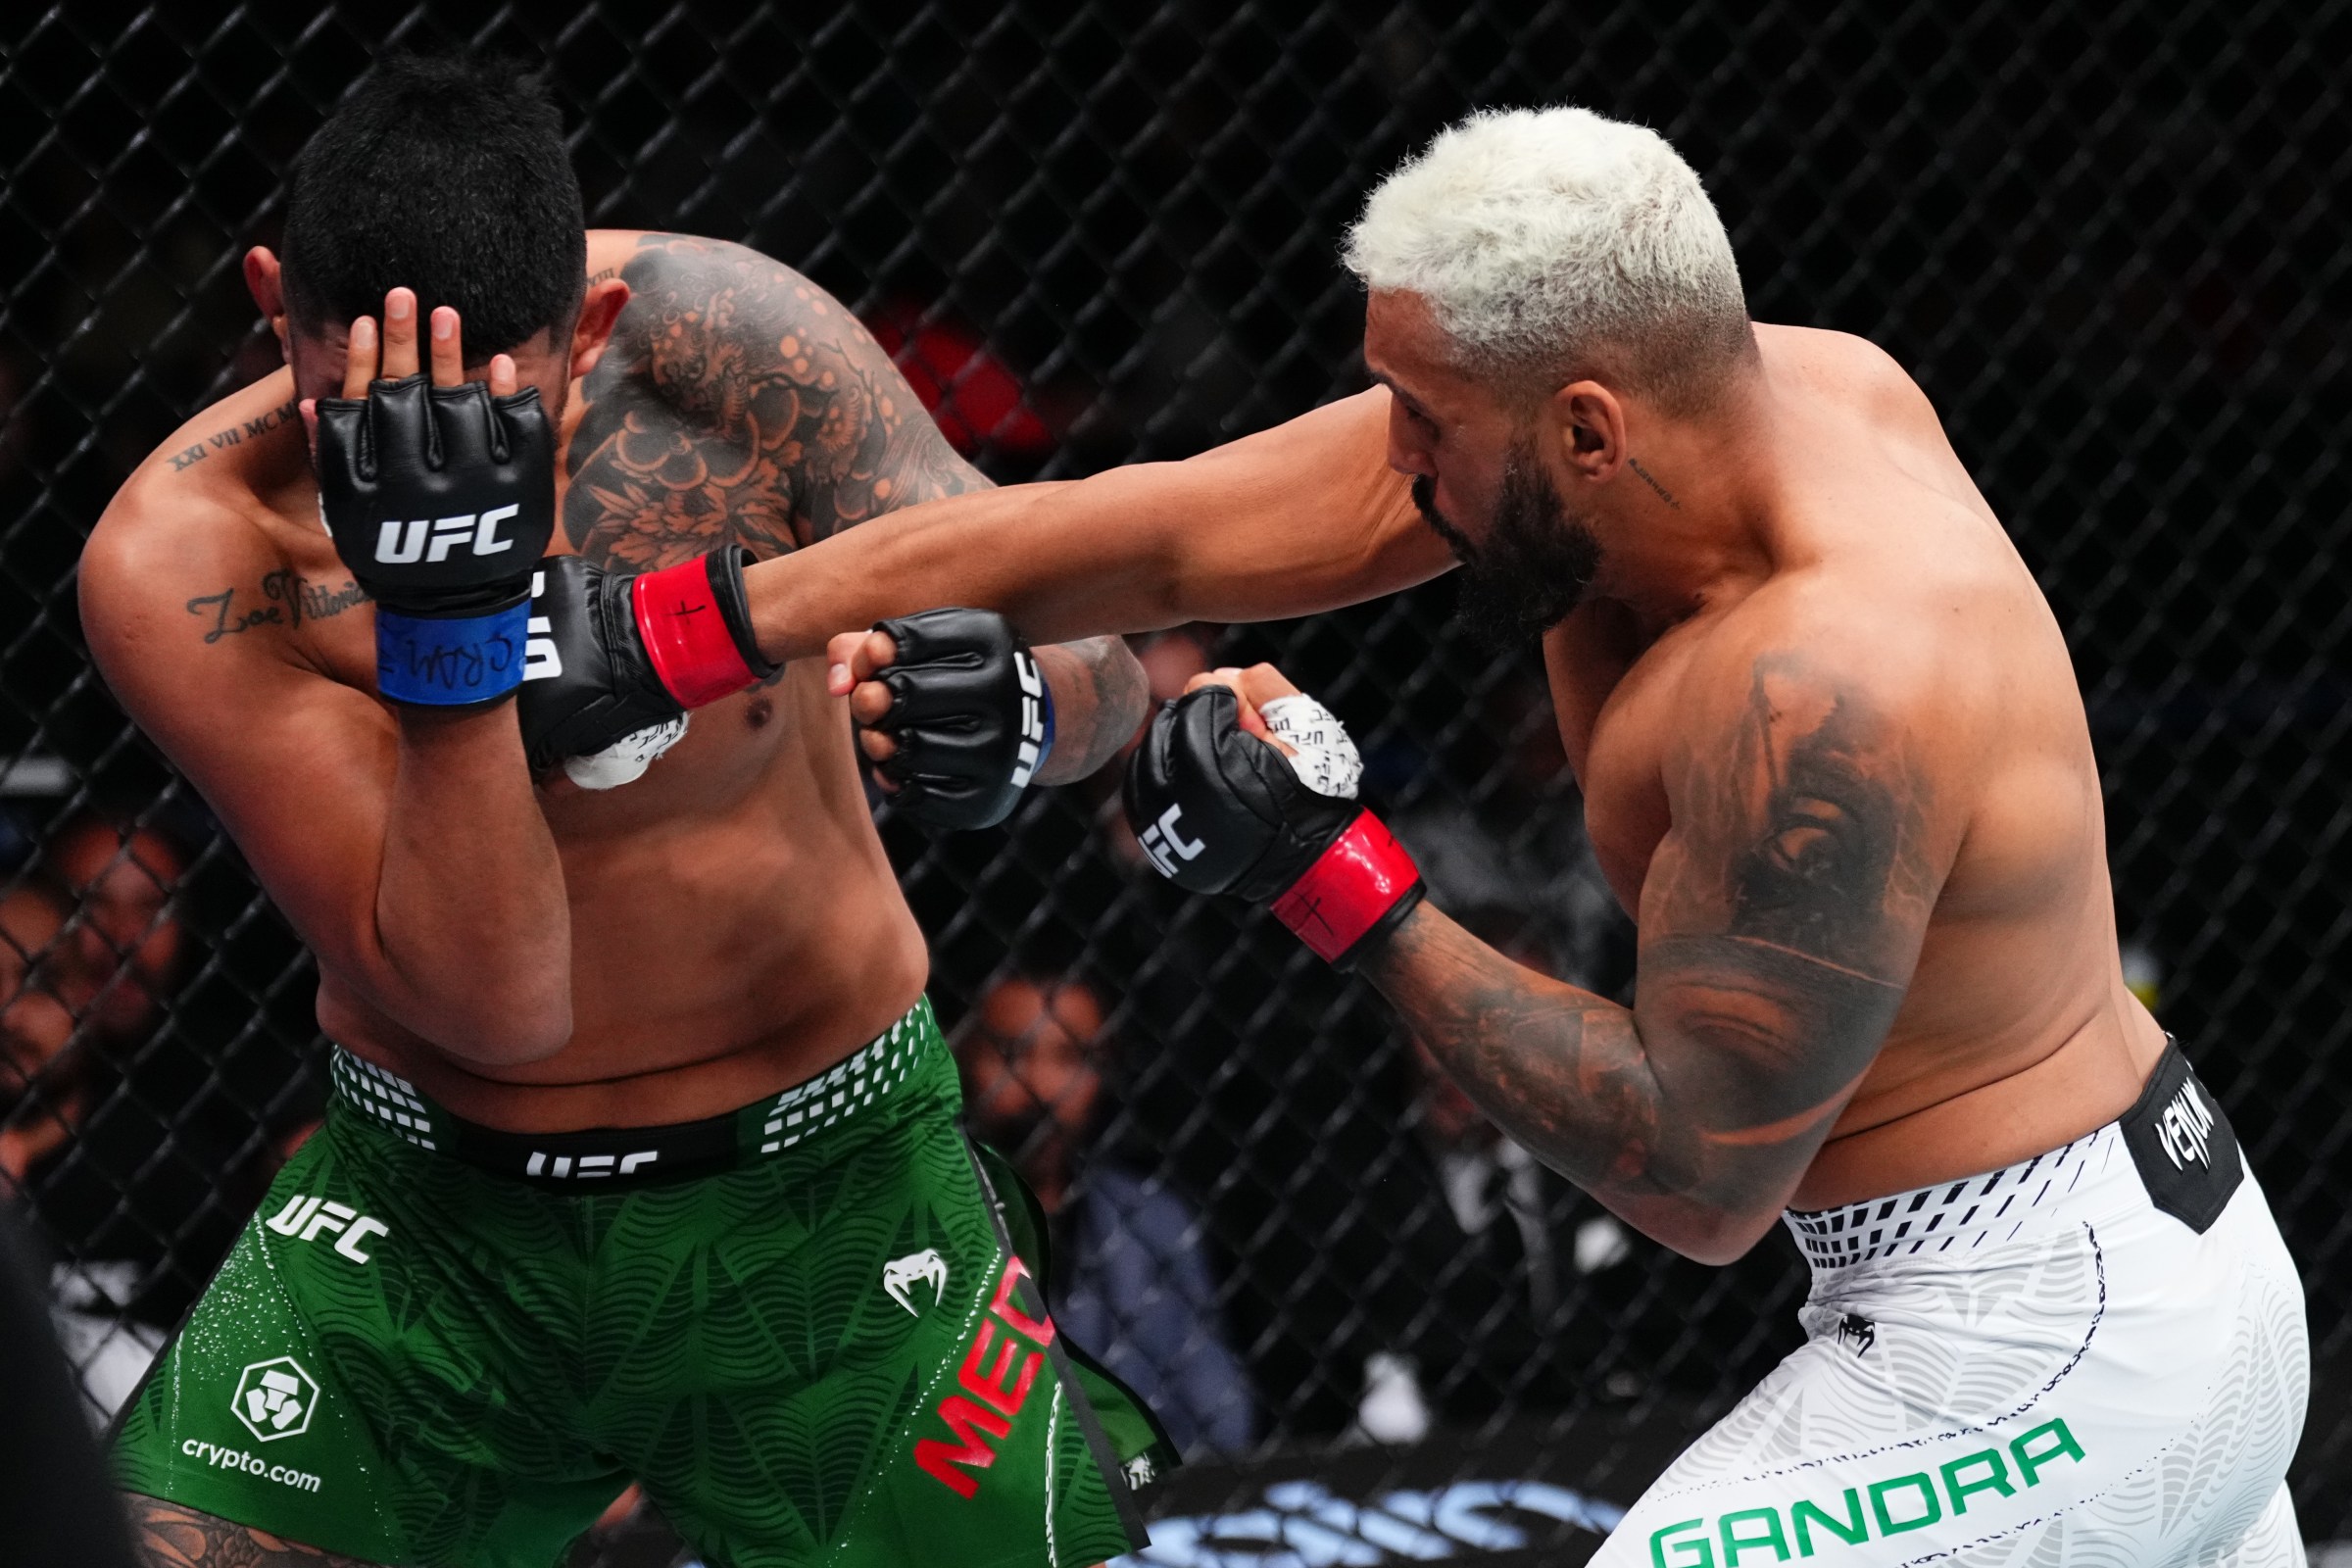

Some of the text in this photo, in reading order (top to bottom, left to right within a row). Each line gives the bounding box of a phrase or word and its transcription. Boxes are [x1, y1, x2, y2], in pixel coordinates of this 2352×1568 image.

[167, 443, 207, 471] XXI
[208, 428, 241, 448] VII
[375, 503, 519, 564] UFC
[1010, 651, 1043, 789] UFC
[2155, 1076, 2214, 1171] VENUM
[266, 1195, 389, 1264] UFC
[182, 1438, 321, 1493] crypto.com
[1648, 1417, 2086, 1568] GANDRA
